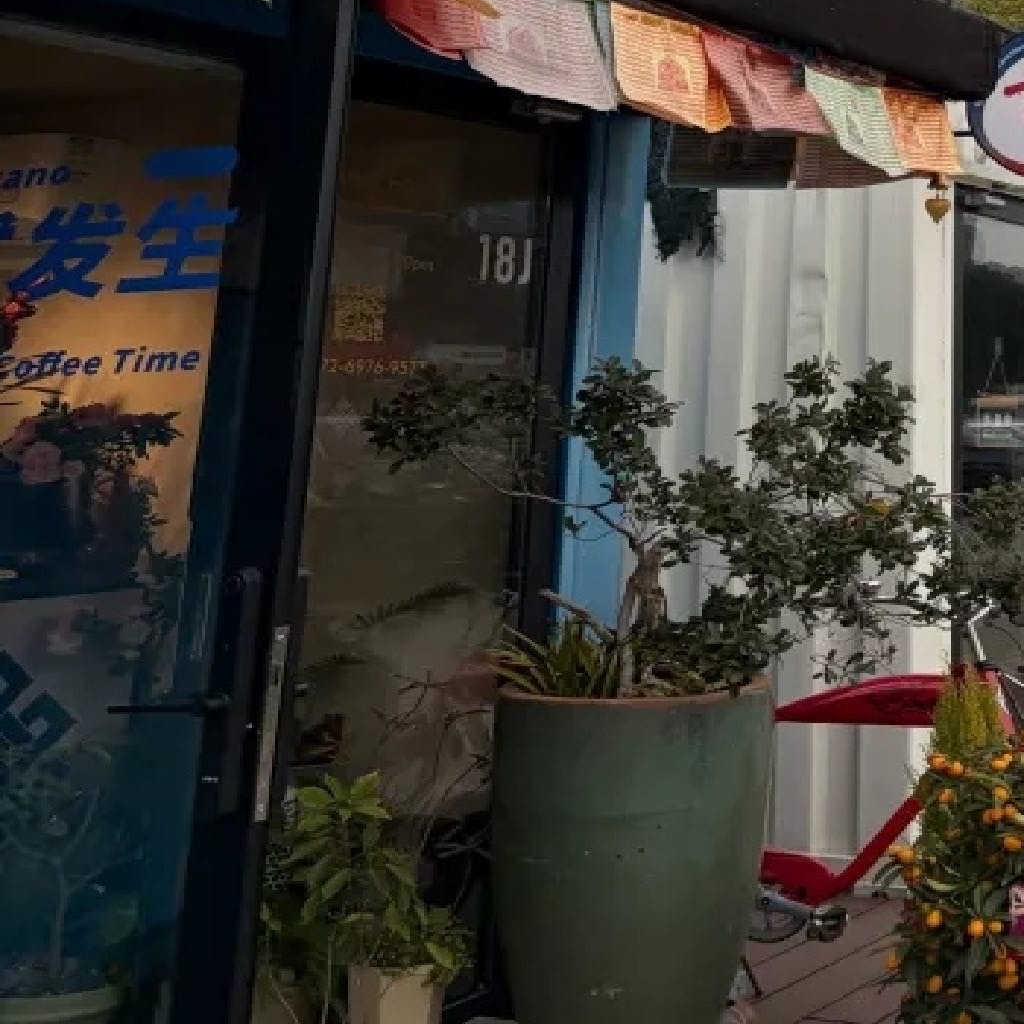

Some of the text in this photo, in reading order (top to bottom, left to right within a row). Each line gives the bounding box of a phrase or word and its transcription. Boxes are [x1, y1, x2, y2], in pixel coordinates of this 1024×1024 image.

[0, 165, 71, 188] ano
[0, 192, 238, 300] 发生
[113, 346, 200, 374] Time
